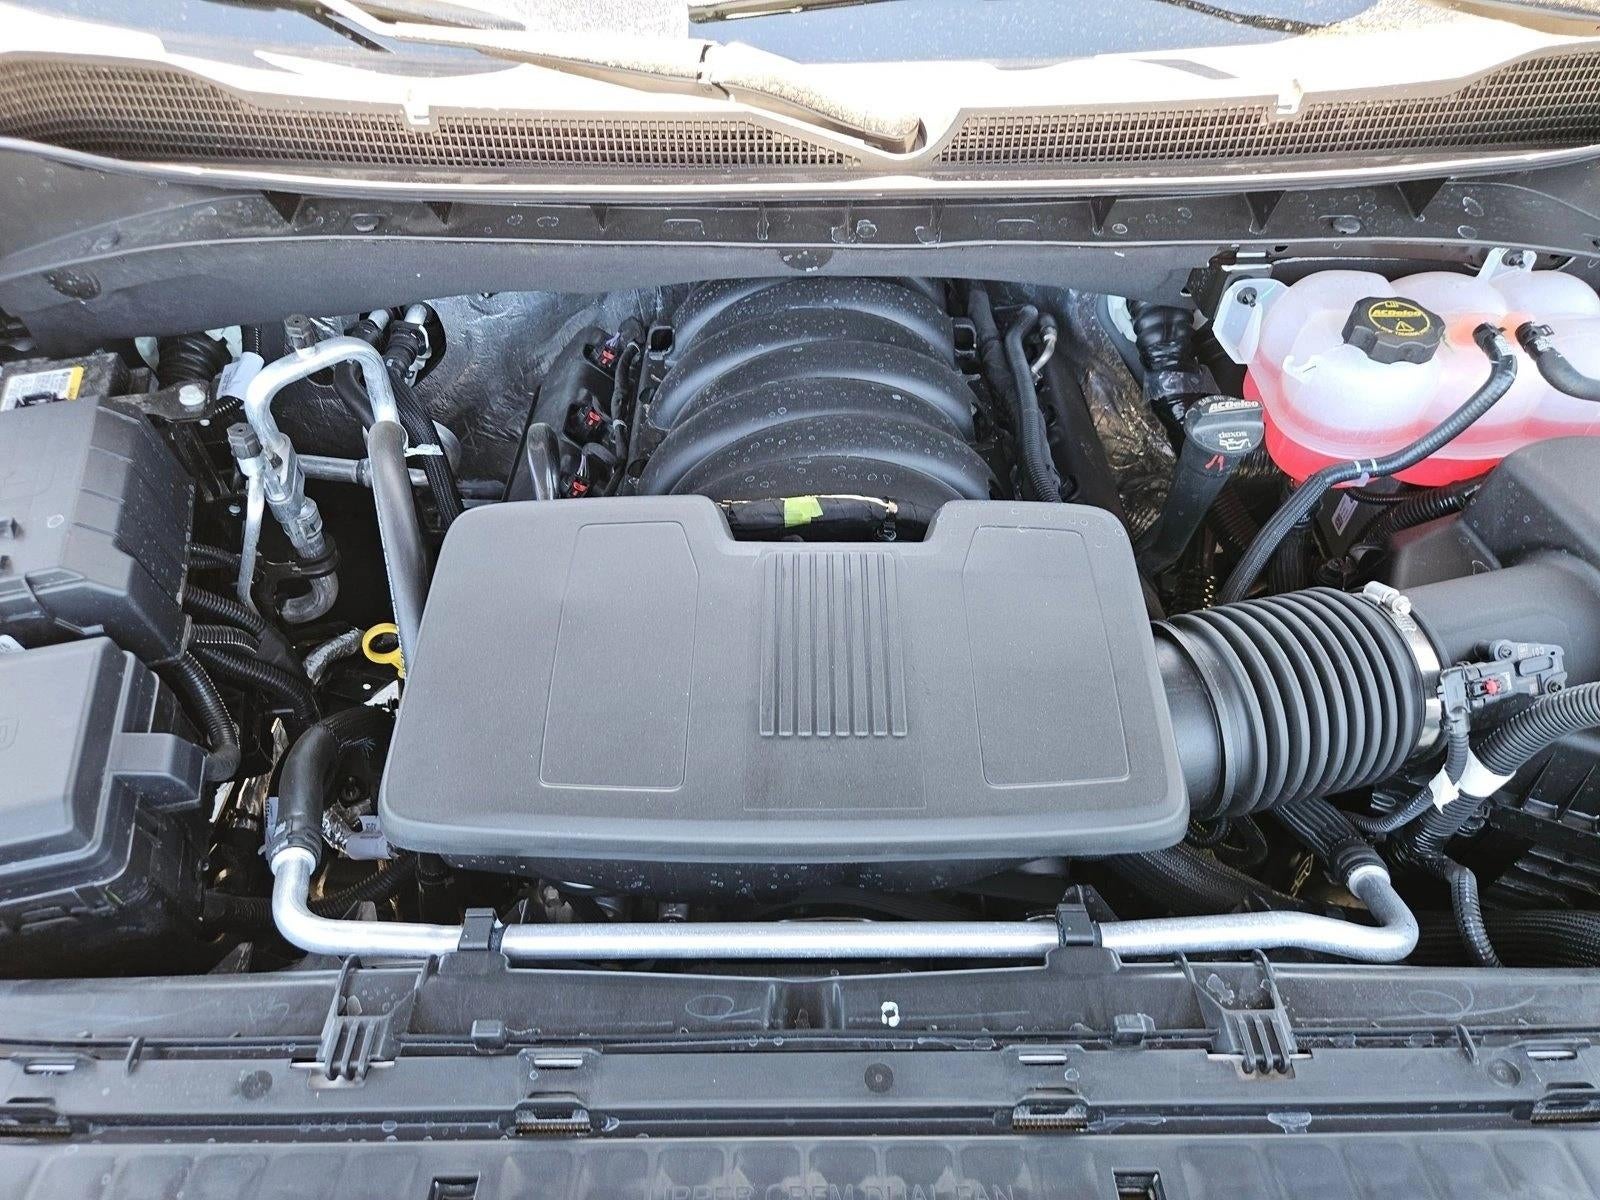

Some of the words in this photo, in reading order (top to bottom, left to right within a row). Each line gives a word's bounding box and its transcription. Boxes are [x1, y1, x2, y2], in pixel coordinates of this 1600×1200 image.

[1371, 309, 1421, 317] ACDelco
[1209, 400, 1259, 413] ACDelco
[1218, 431, 1248, 439] dexos
